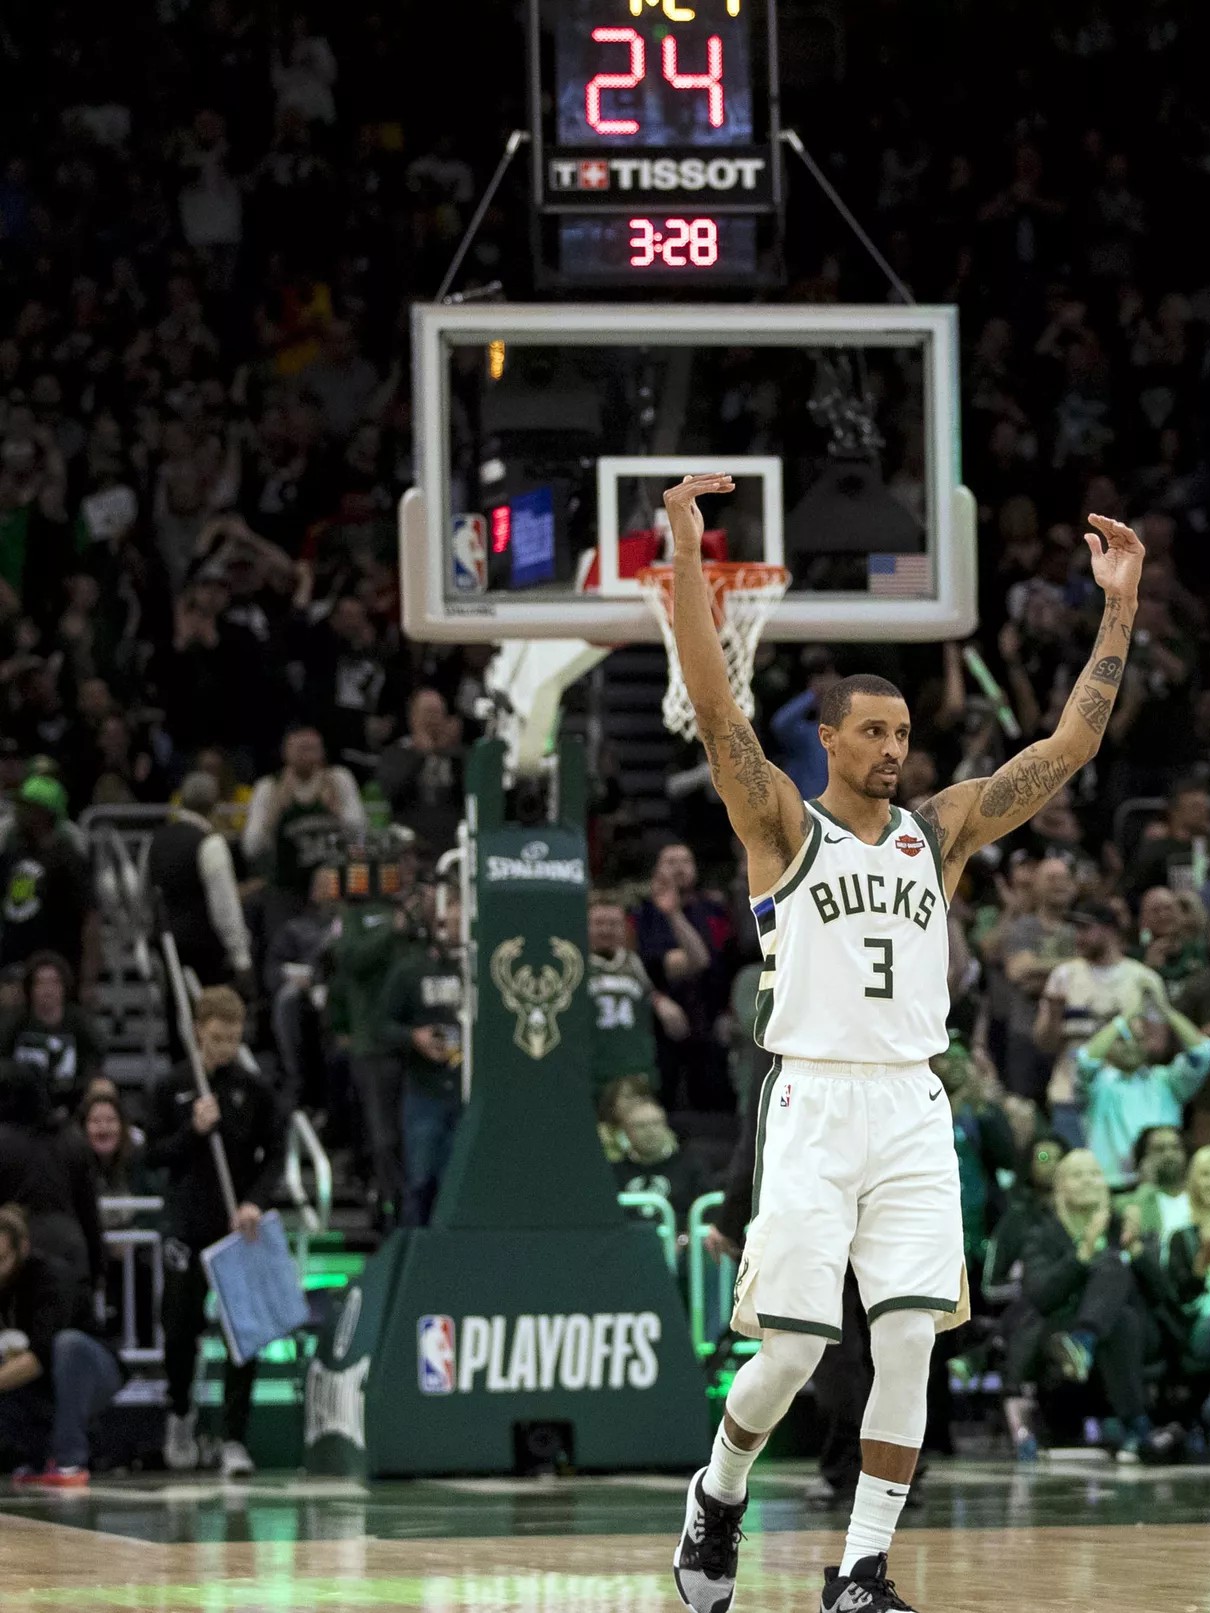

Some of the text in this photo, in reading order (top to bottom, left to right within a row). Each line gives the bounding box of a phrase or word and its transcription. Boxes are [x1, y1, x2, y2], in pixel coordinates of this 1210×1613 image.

[586, 28, 723, 134] 24
[610, 158, 765, 190] TISSOT
[629, 218, 718, 266] 3:28
[809, 874, 937, 931] BUCKS
[864, 937, 893, 999] 3
[457, 1311, 662, 1393] PLAYOFFS
